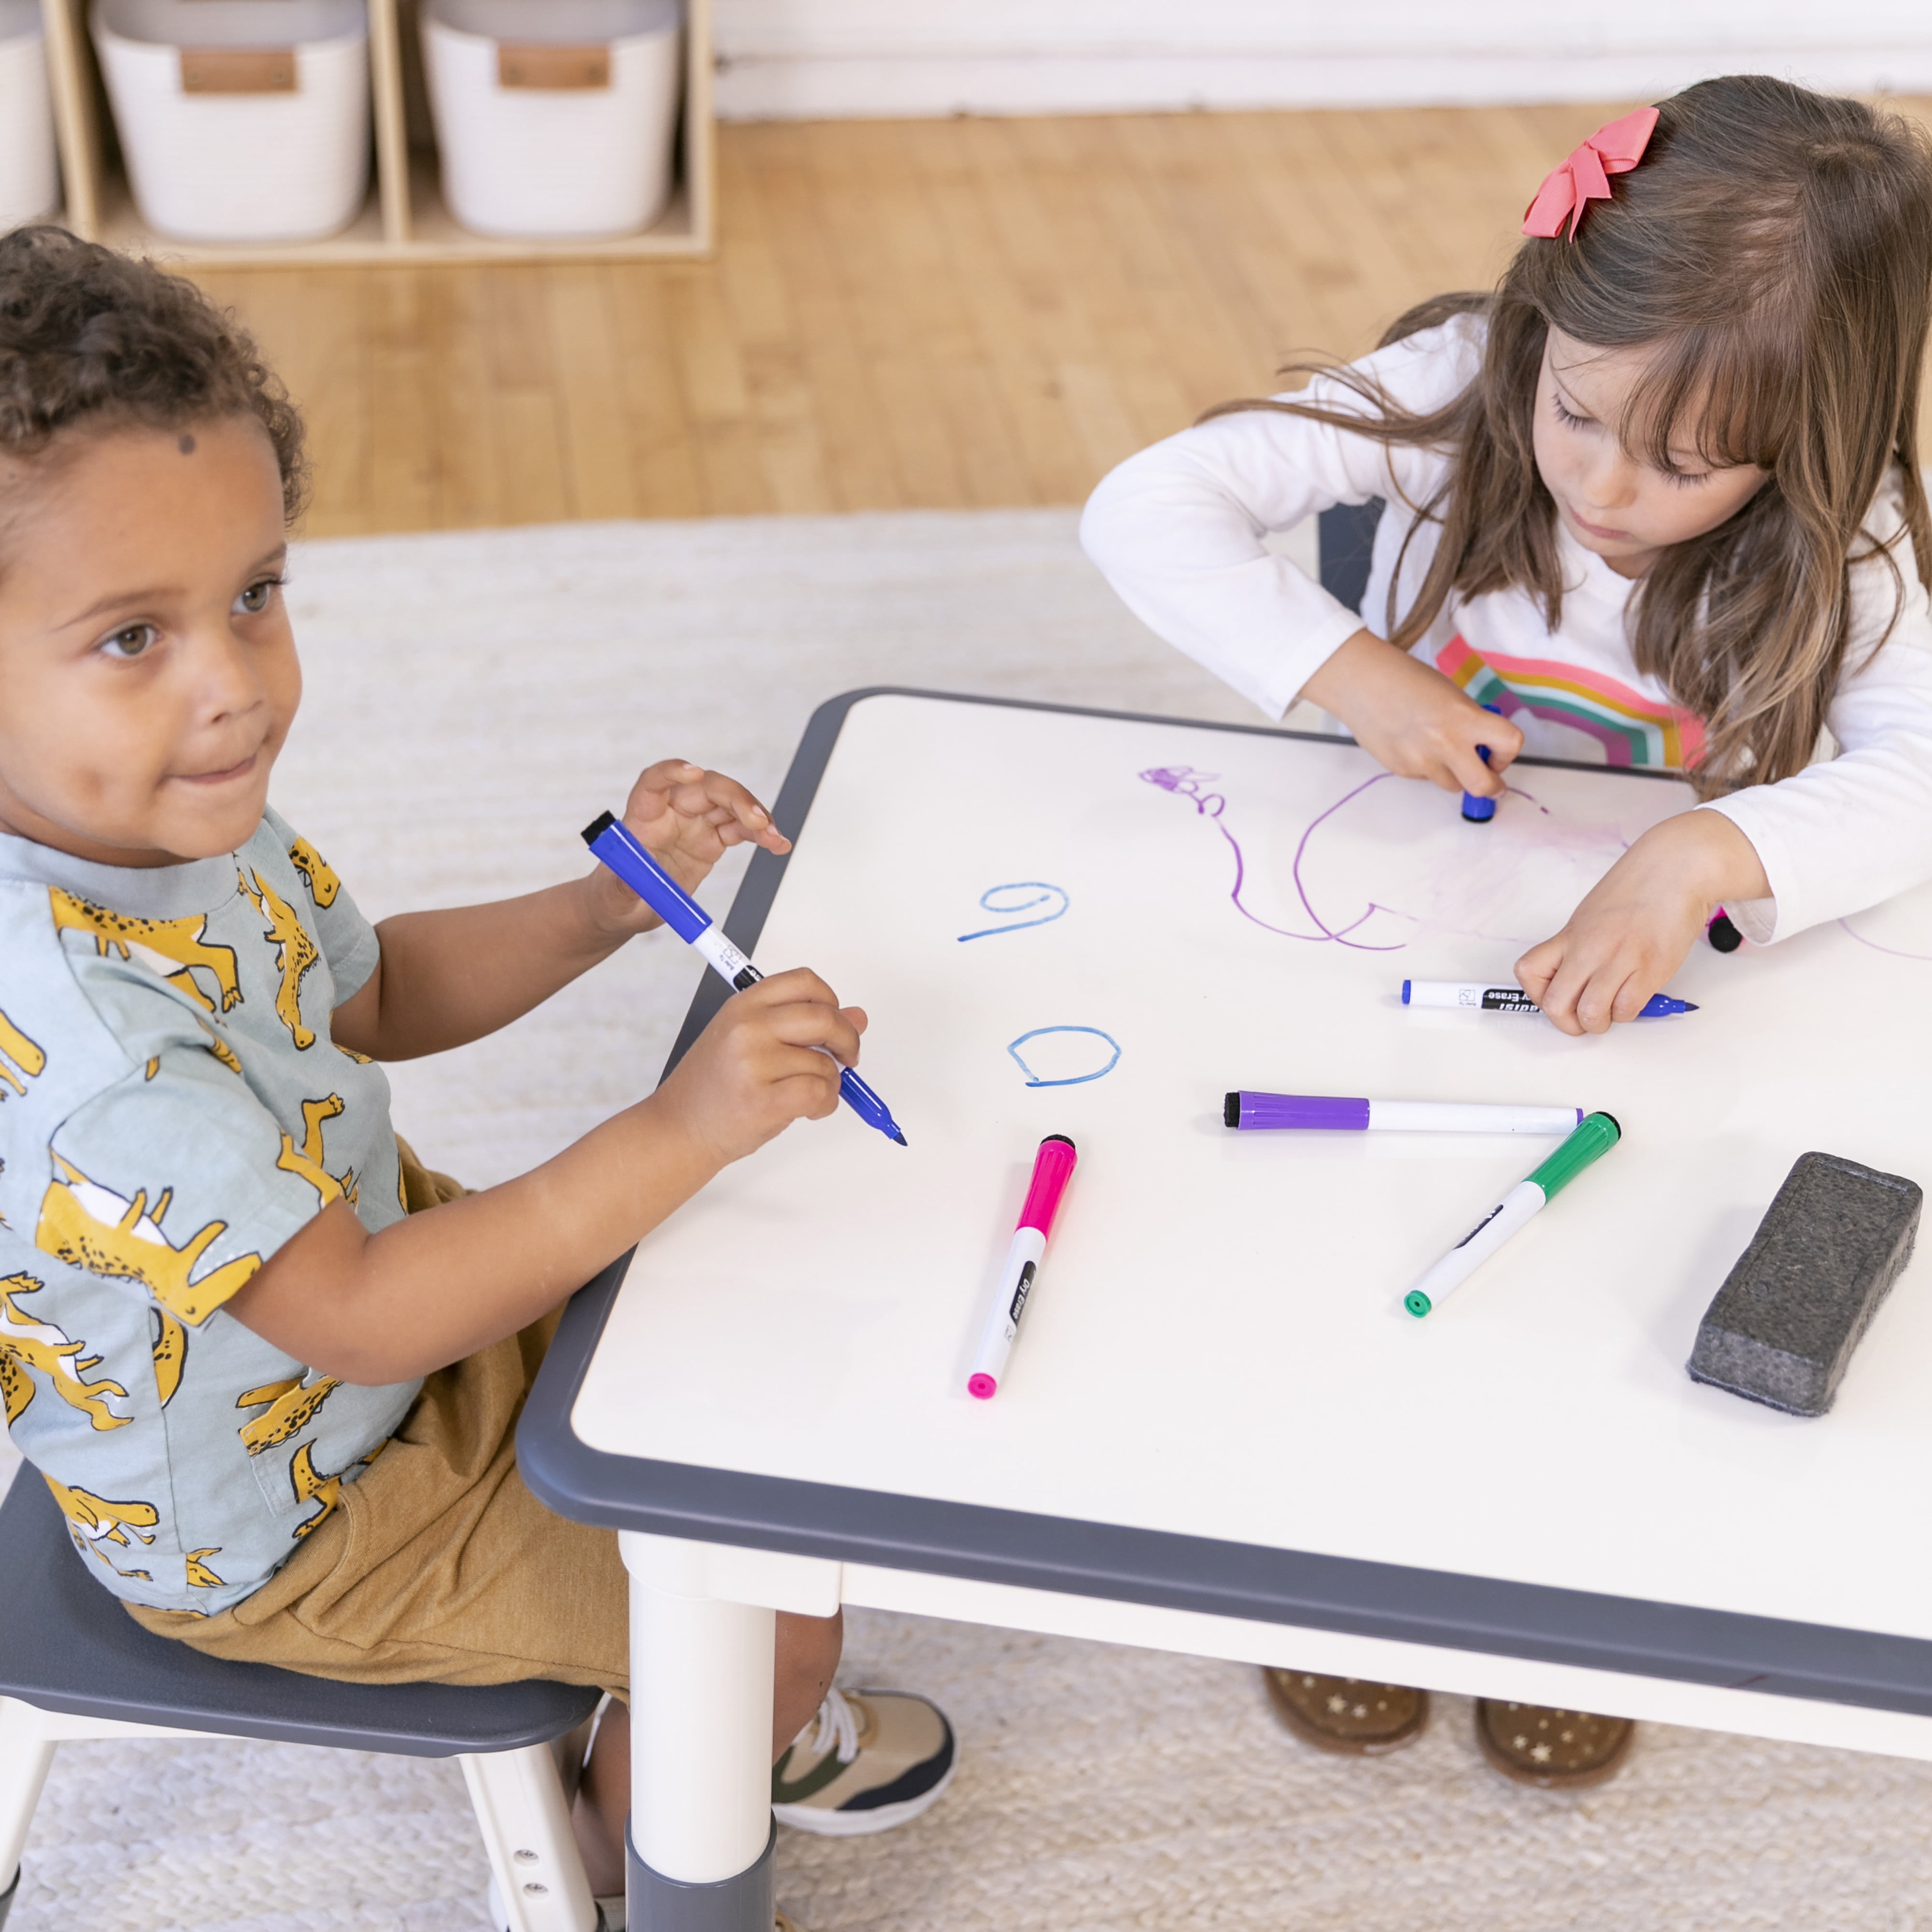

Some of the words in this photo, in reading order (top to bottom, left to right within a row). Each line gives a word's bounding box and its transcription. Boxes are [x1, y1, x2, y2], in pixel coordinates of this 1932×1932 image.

[1488, 992, 1519, 1002] Erase
[1019, 1279, 1030, 1295] Dry
[1012, 1294, 1025, 1319] Erase
